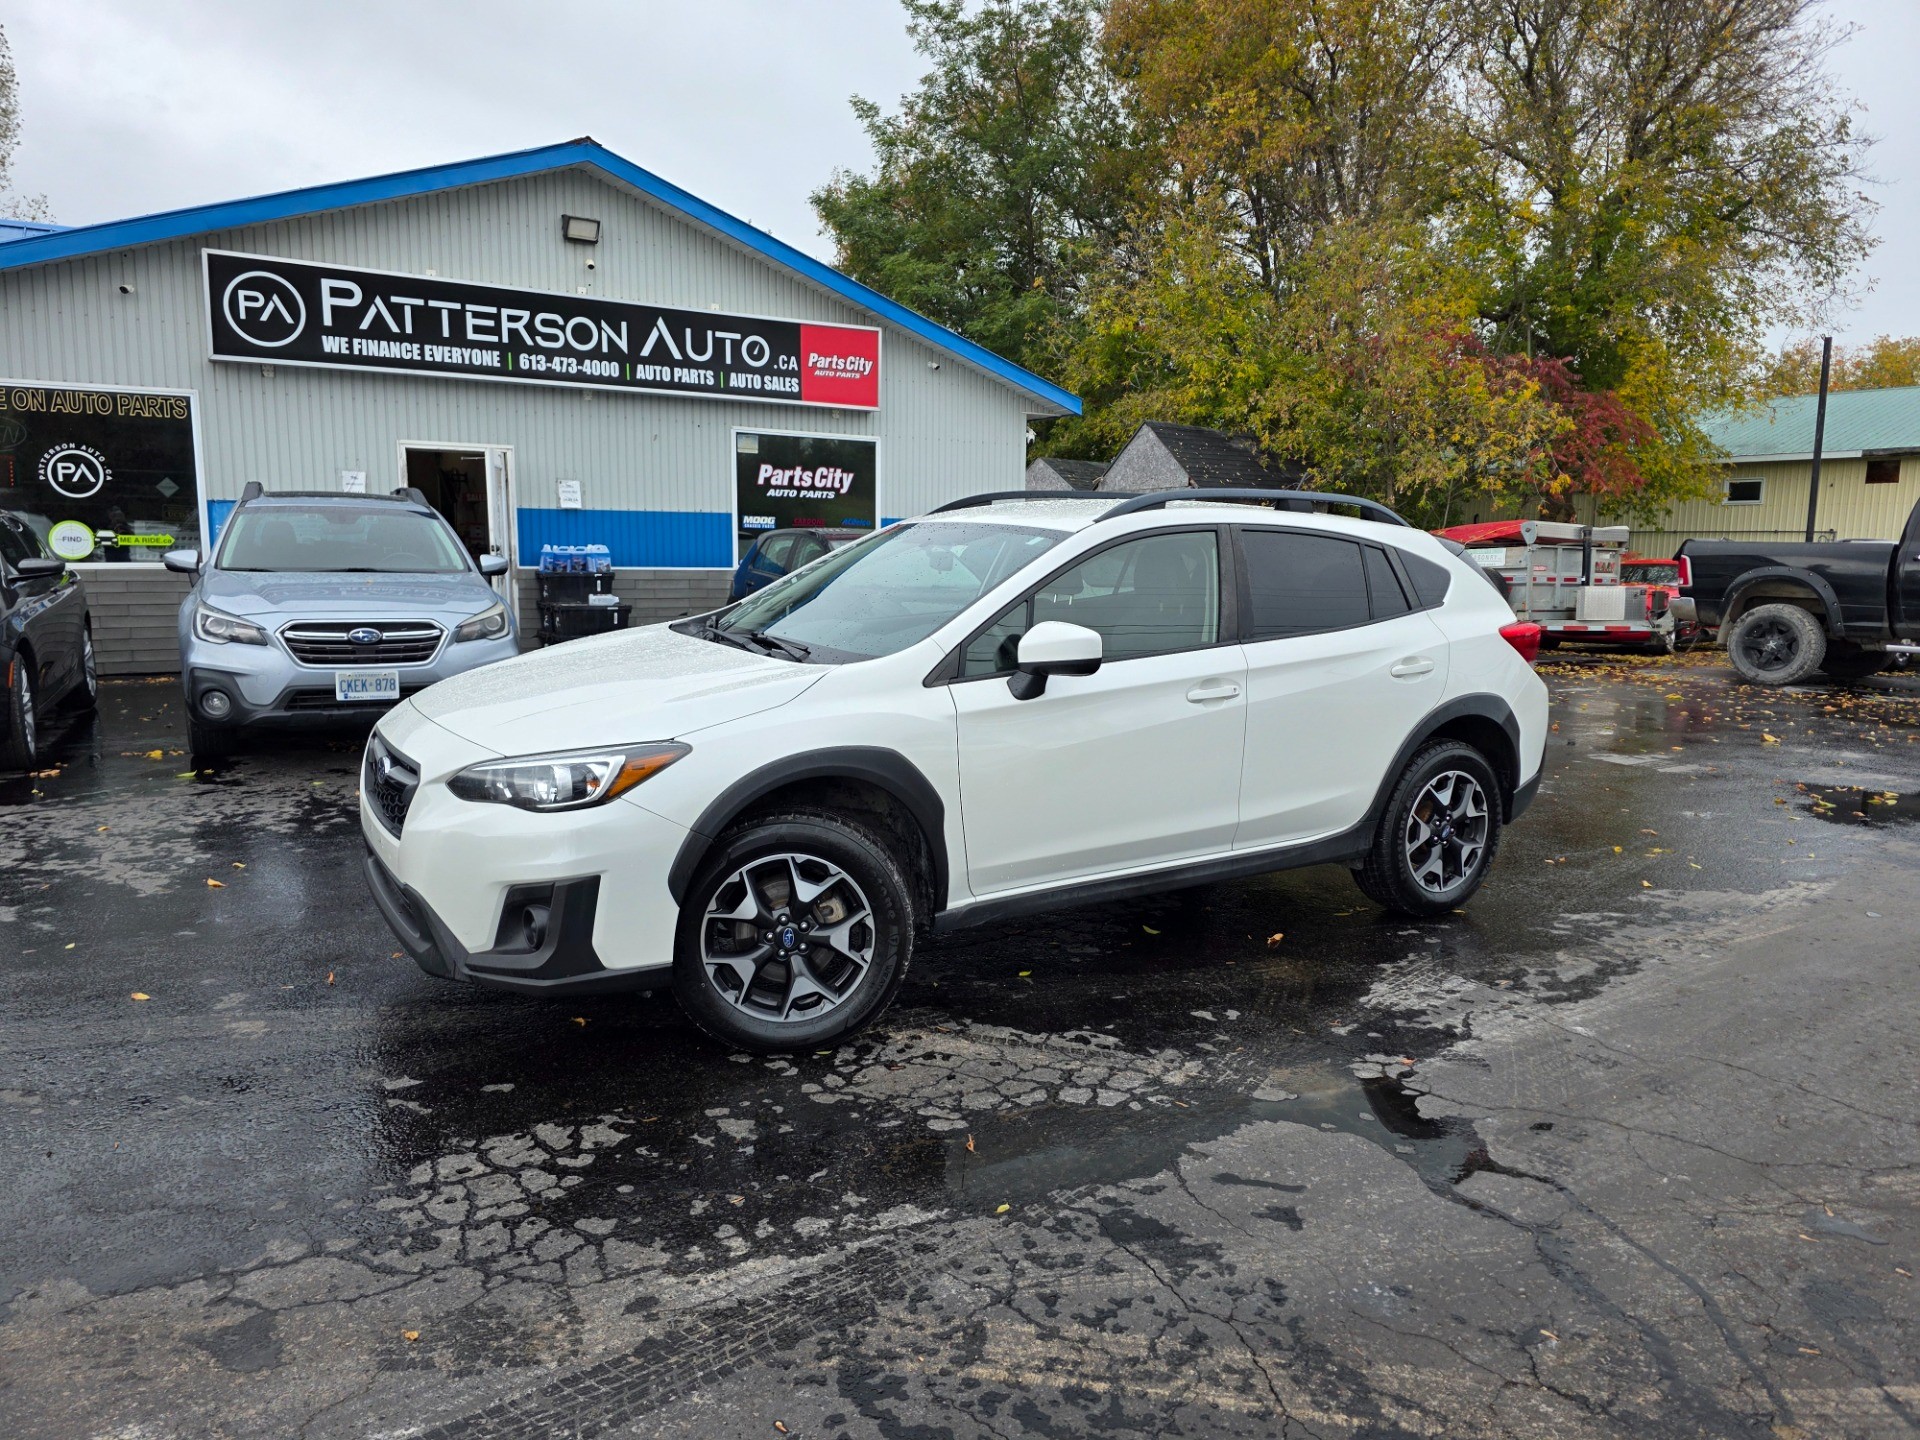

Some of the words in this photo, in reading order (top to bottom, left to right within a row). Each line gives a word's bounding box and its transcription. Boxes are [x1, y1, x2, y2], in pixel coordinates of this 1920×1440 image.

[237, 289, 295, 325] PA
[320, 277, 628, 355] PATTERSON
[321, 335, 350, 354] WE
[353, 338, 422, 361] FINANCE
[424, 344, 501, 367] EVERYONE
[518, 353, 620, 378] 613-473-4000
[636, 364, 671, 382] AUTO
[673, 367, 715, 386] PARTS
[813, 369, 835, 377] AUTO
[835, 371, 861, 379] PARTS
[729, 372, 762, 389] AUTO
[763, 374, 800, 393] SALES
[11, 388, 47, 412] ON
[50, 390, 113, 416] AUTO
[117, 393, 188, 419] PARTS
[38, 442, 76, 481] PATTERSON
[80, 444, 106, 462] AUTO
[57, 462, 97, 482] PA
[766, 488, 798, 498] AUTO
[799, 490, 836, 499] PARTS
[340, 679, 368, 692] CKEK
[375, 678, 396, 691] 878
